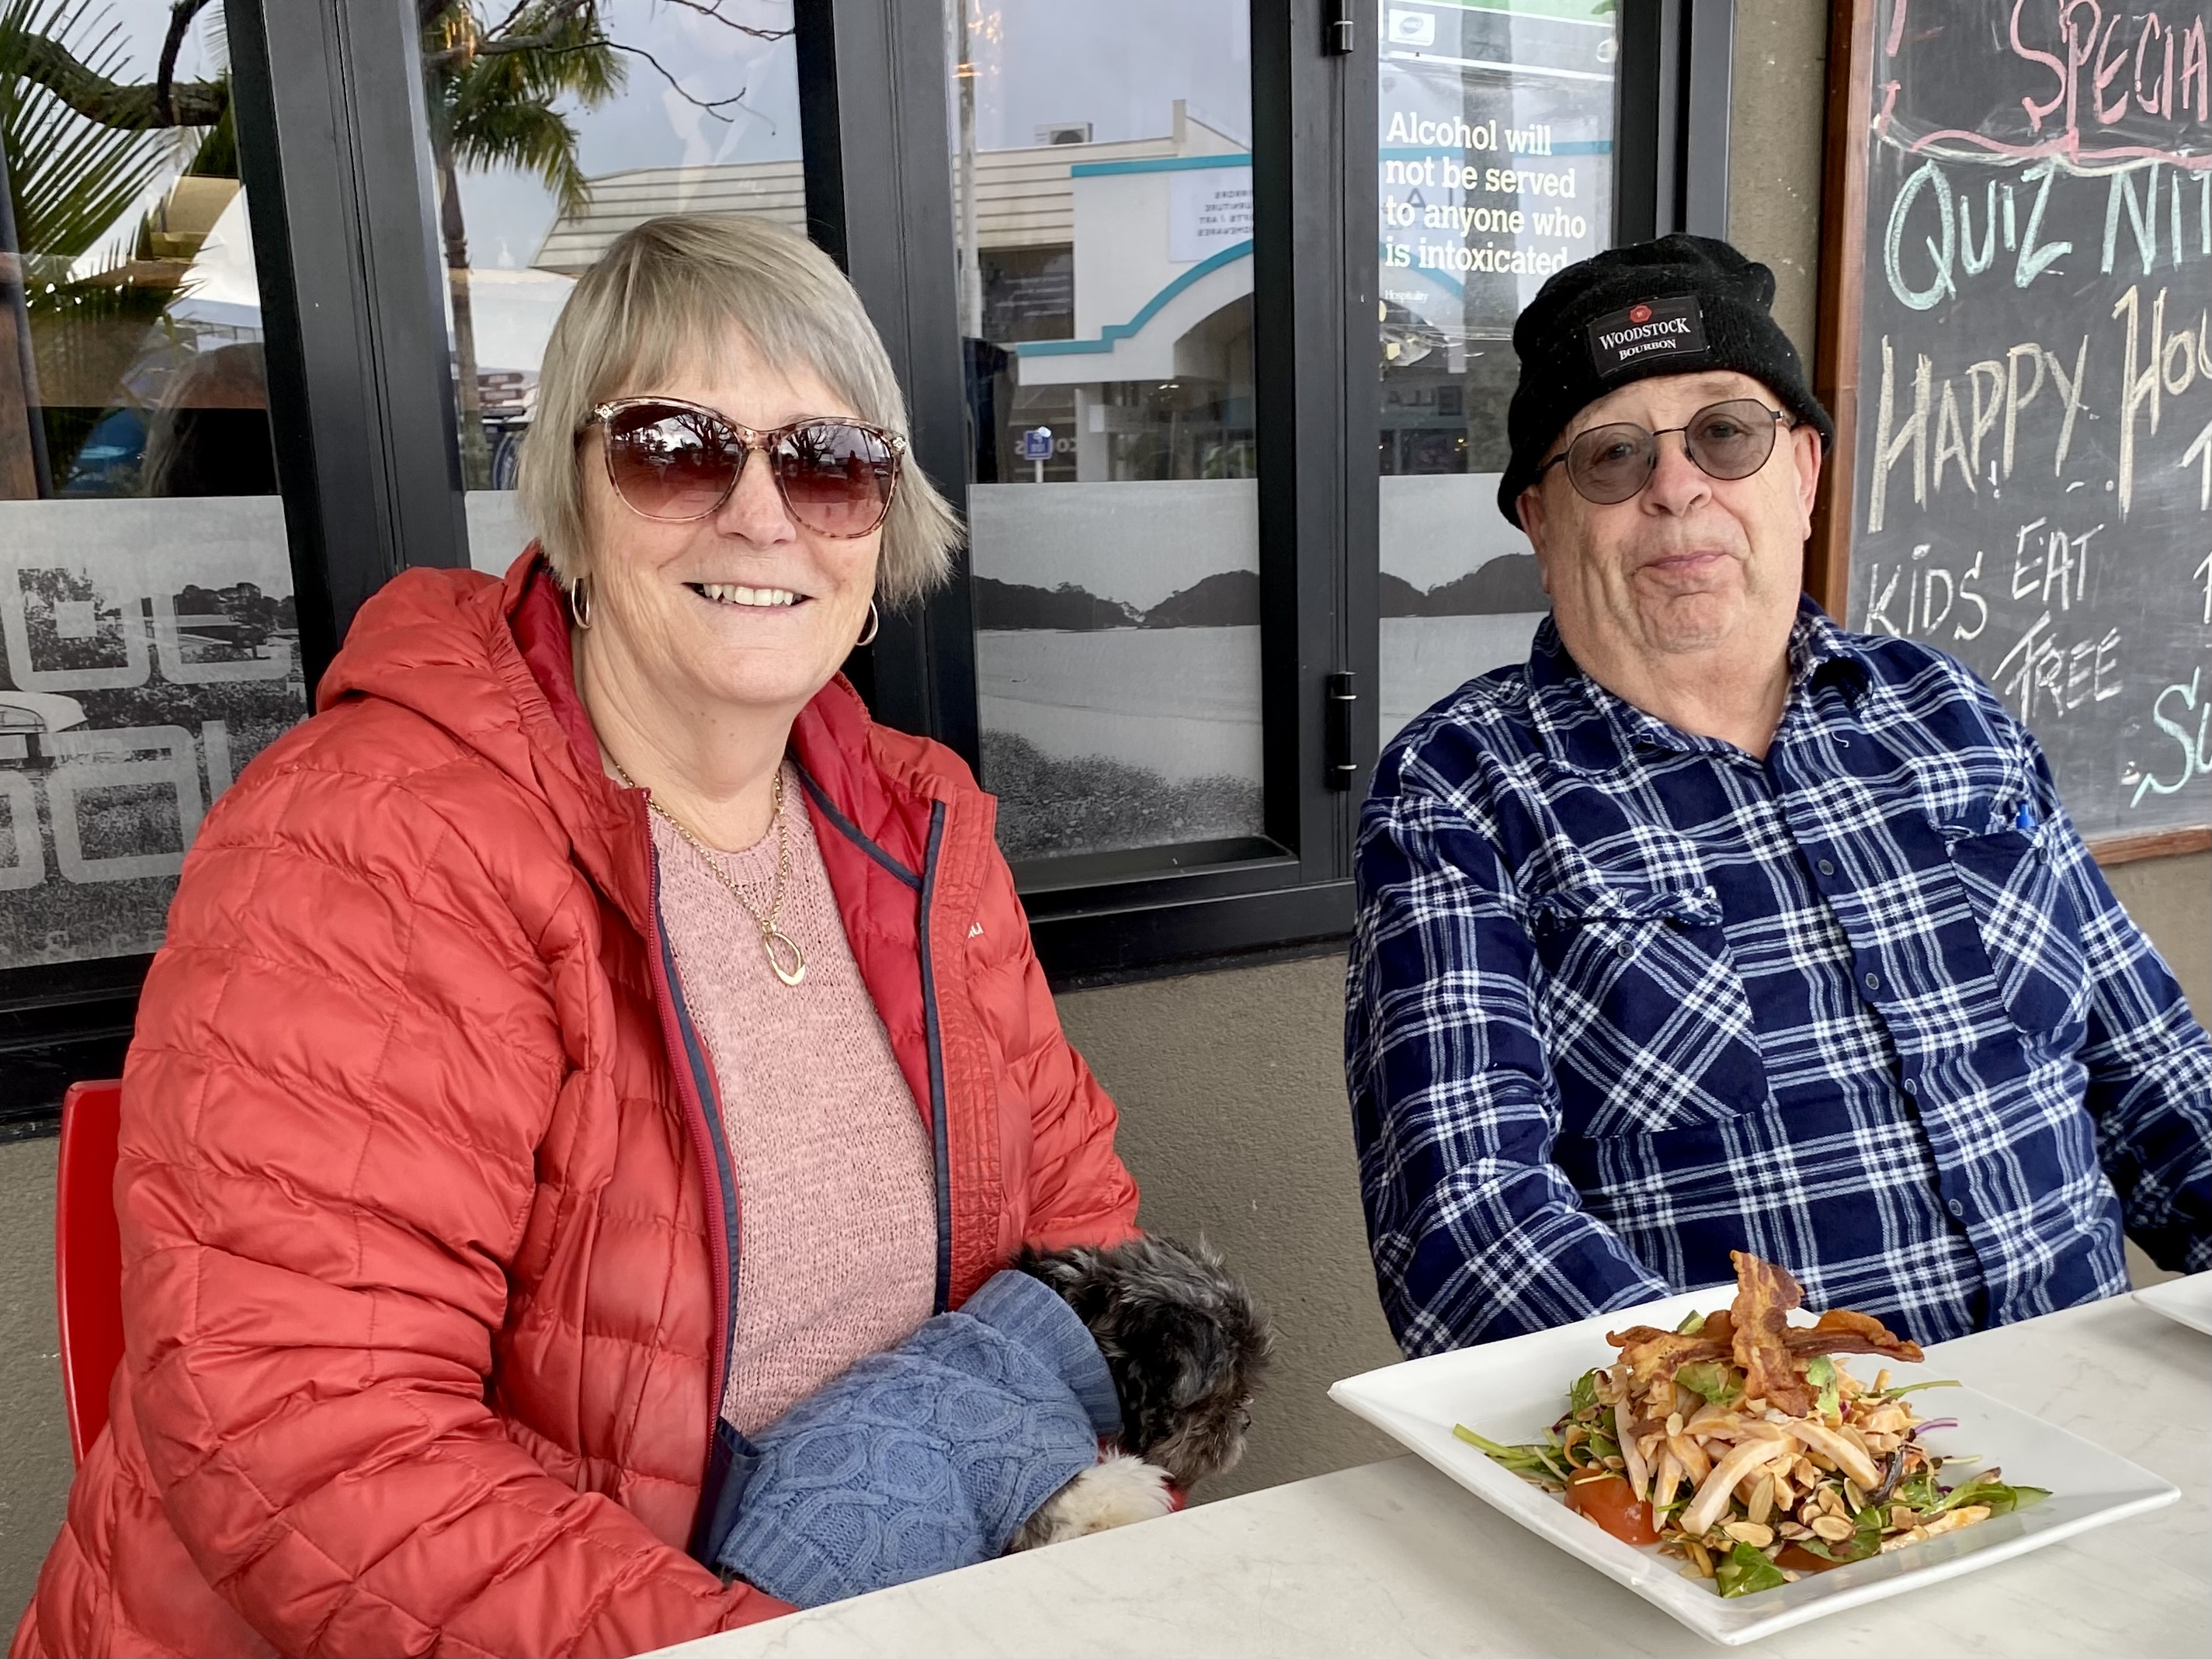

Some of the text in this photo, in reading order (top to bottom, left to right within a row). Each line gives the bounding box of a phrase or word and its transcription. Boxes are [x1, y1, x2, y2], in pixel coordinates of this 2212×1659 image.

[1386, 111, 1552, 155] Alcohol will
[1386, 157, 1435, 187] not
[1443, 156, 1478, 189] be
[1485, 168, 1576, 199] served
[1386, 195, 1415, 227] to
[1424, 203, 1525, 237] anyone
[1533, 207, 1586, 238] who
[1385, 237, 1568, 275] is intoxicated
[1598, 318, 1691, 349] WOODSTOCK
[1619, 338, 1676, 361] BOURBON
[1868, 335, 2089, 533] HAPPY
[2012, 517, 2105, 611] EAT
